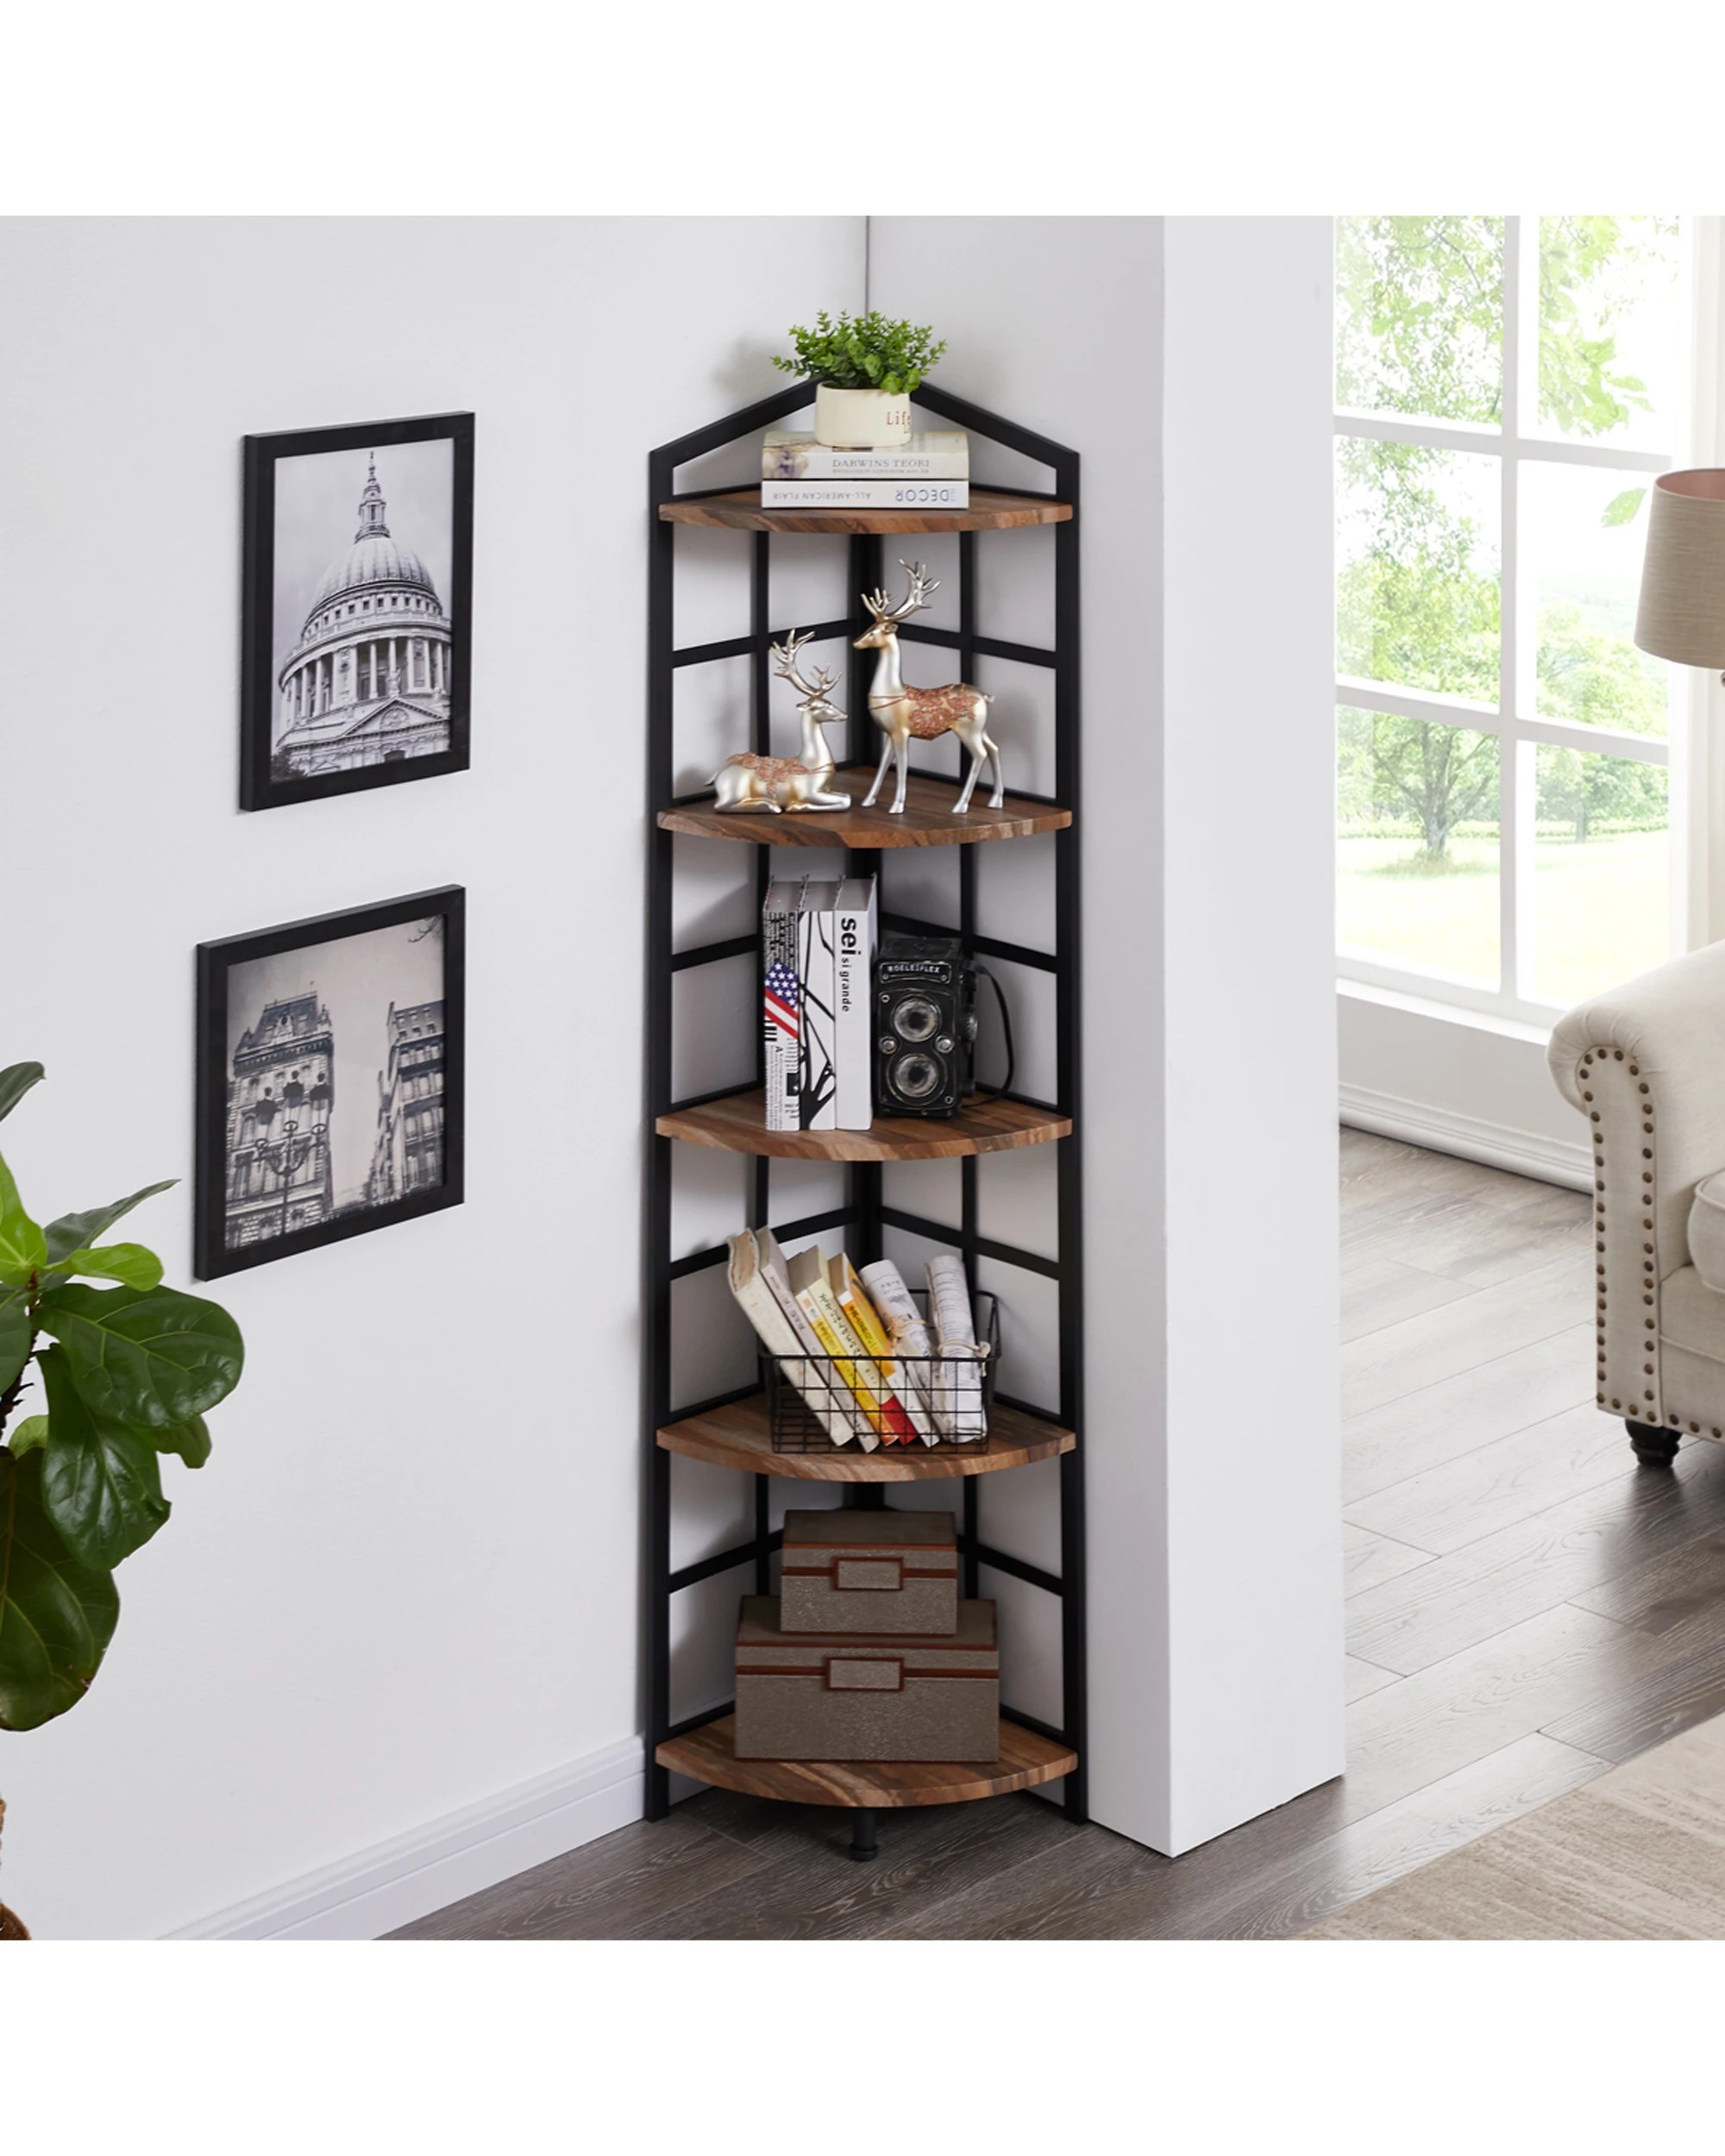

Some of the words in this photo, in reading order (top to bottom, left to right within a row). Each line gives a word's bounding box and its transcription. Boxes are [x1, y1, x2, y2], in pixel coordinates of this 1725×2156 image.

[832, 459, 889, 467] DARWINS
[893, 459, 930, 467] TEORI
[773, 492, 799, 500] FLAIR
[802, 492, 871, 500] ALL-AMERICAN
[895, 489, 950, 502] DECOR
[841, 918, 862, 956] sei
